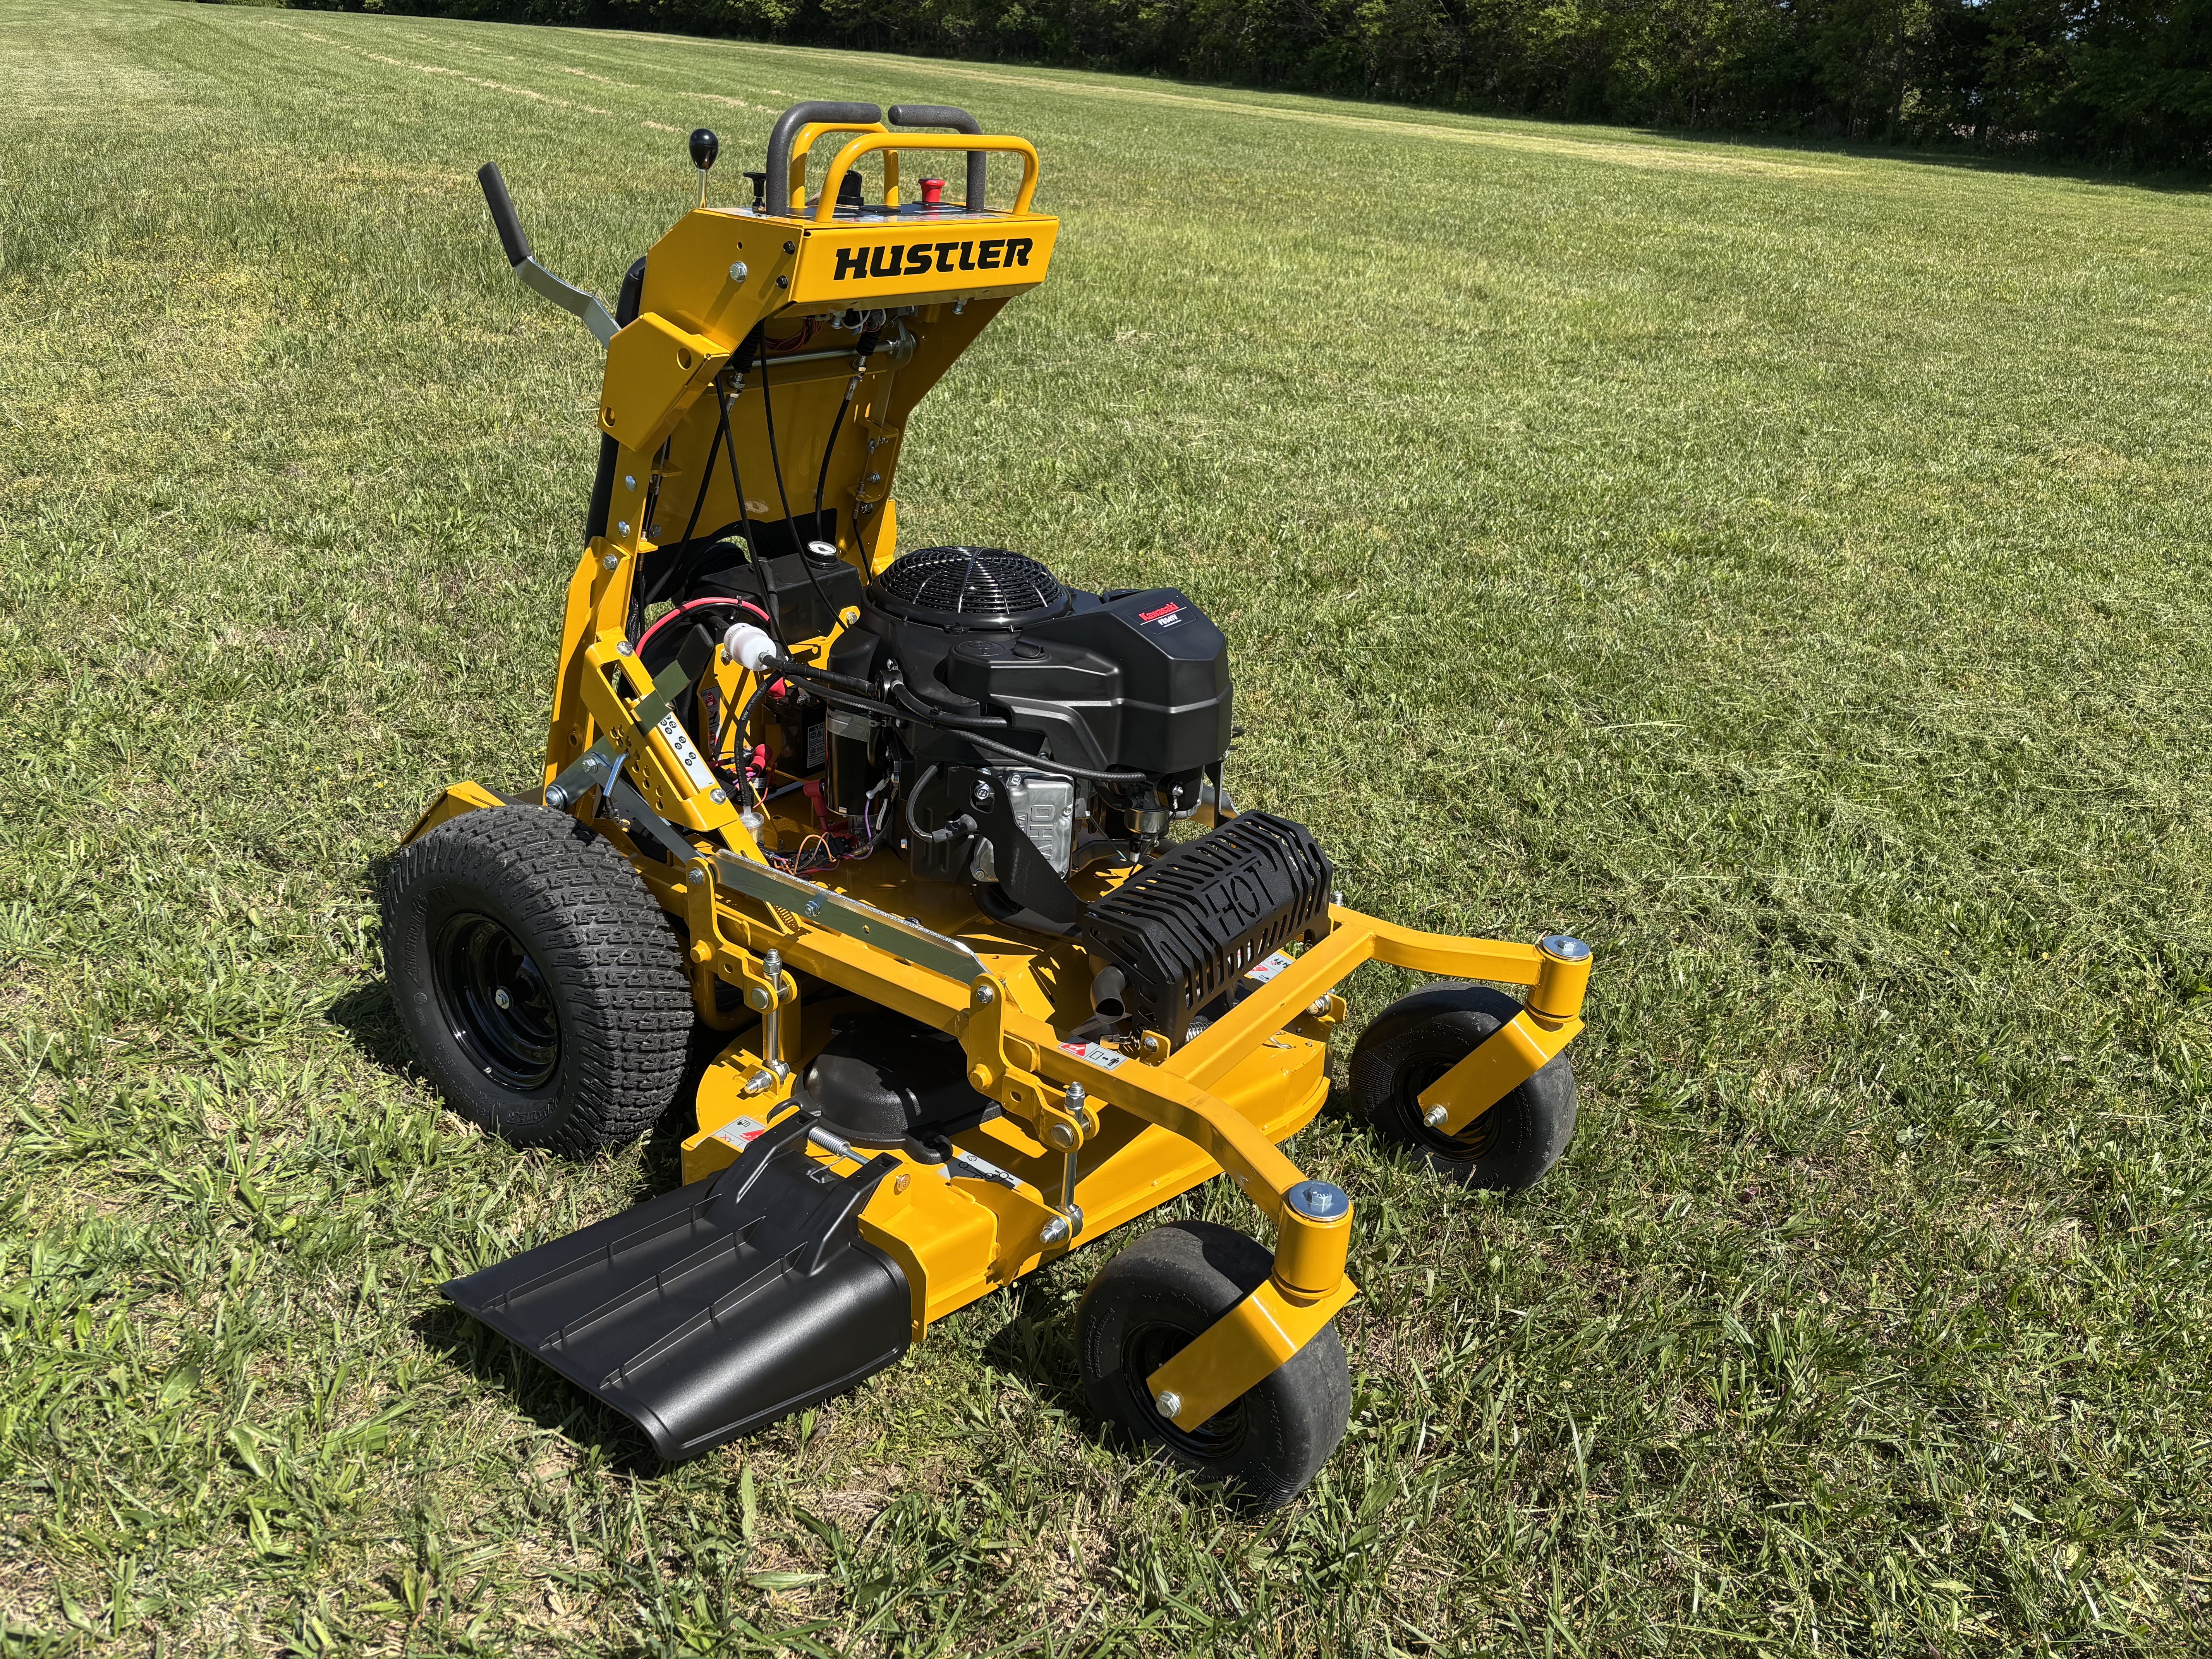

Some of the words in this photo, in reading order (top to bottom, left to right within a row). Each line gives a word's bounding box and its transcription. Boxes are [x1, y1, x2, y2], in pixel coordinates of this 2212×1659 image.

[833, 238, 1033, 280] HUSTLER
[1139, 602, 1179, 621] Kawasaki
[1030, 805, 1054, 860] OHV
[1205, 860, 1275, 937] HOT
[436, 1041, 456, 1068] SERVICE
